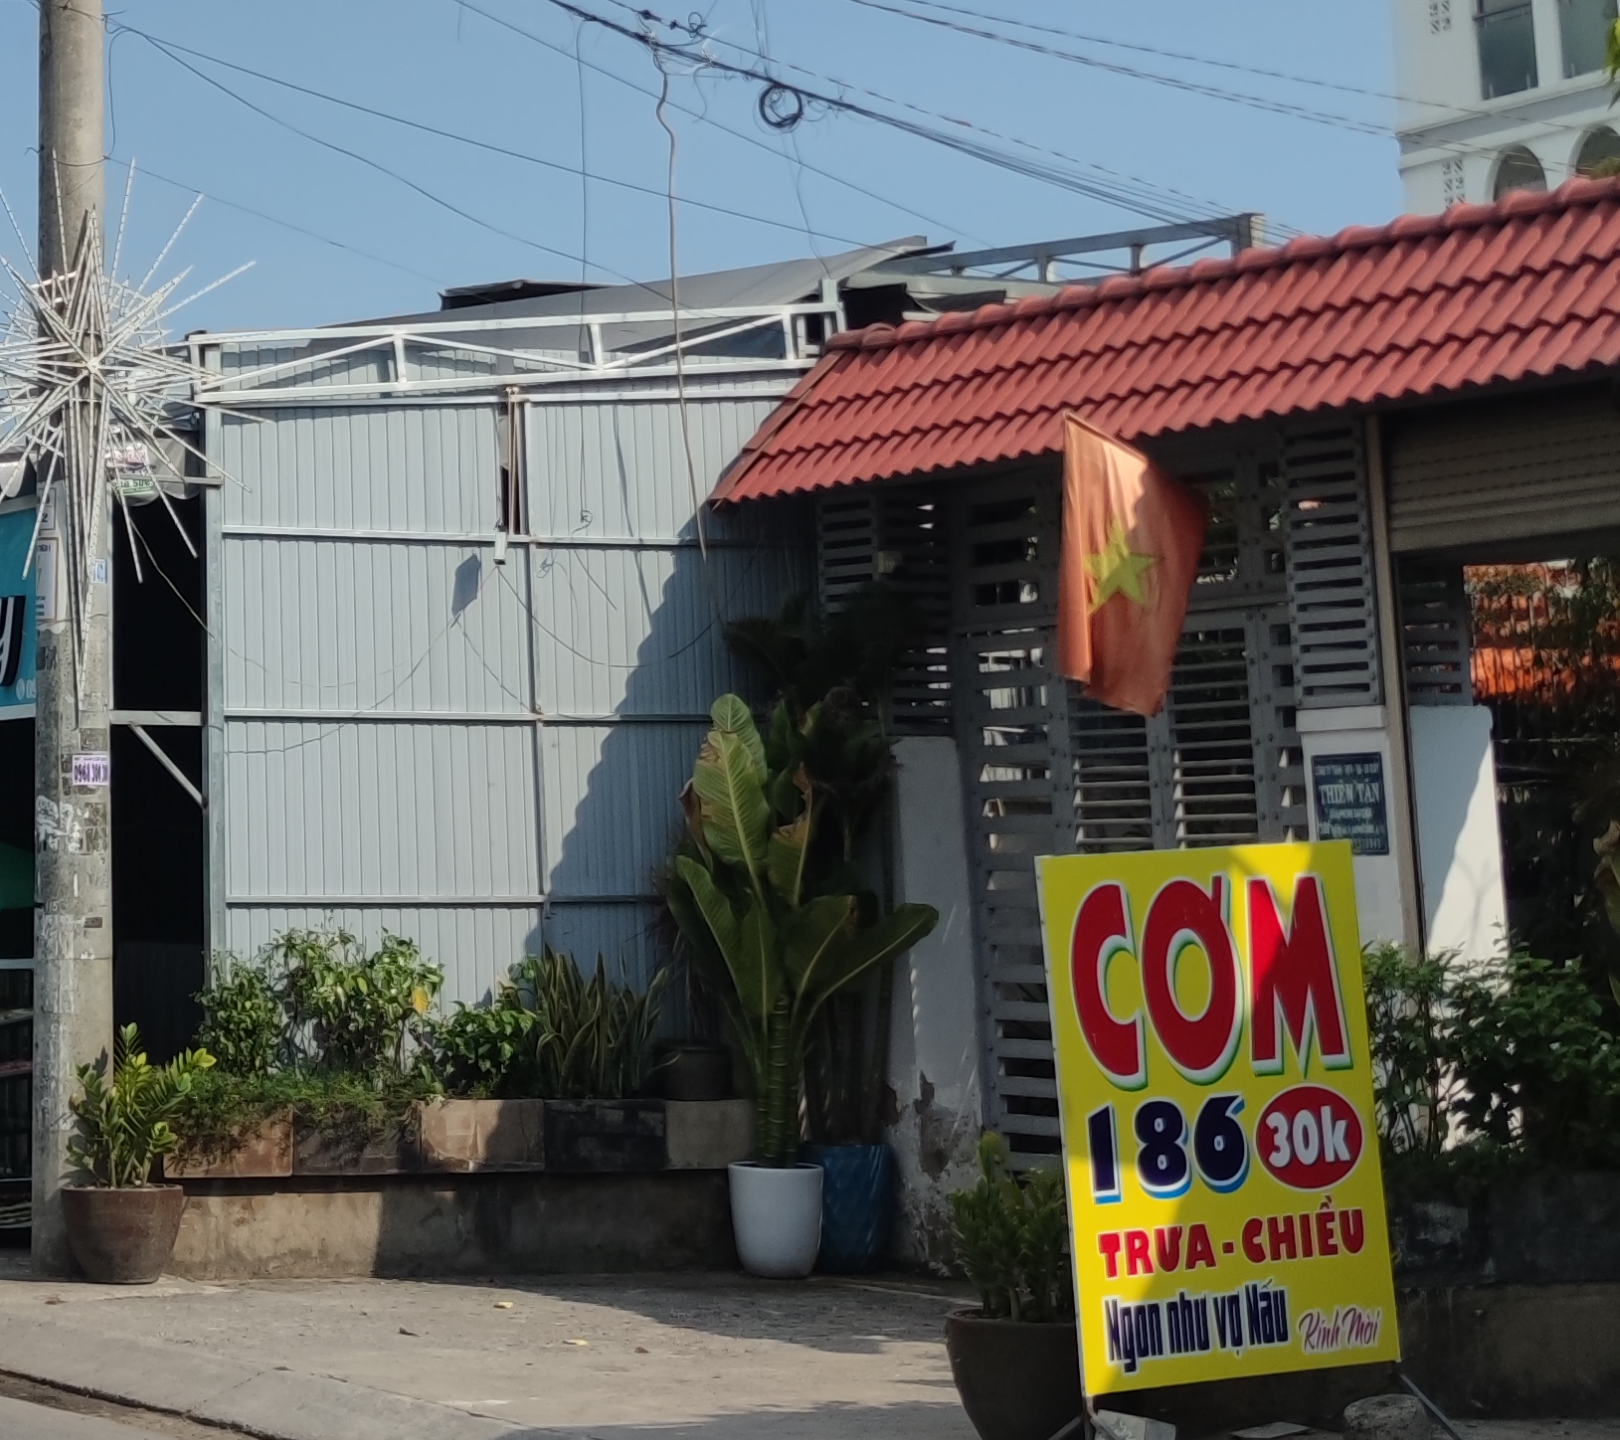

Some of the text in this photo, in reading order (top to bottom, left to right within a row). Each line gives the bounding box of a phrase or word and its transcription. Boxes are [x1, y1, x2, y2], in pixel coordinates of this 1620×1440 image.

[1069, 872, 1354, 1091] CƠM
[1087, 1092, 1251, 1205] 186
[1265, 1105, 1351, 1168] 30k
[1097, 1221, 1217, 1279] TRƯA
[1241, 1195, 1366, 1265] CHIỀU
[1103, 1278, 1290, 1375] Ngon như vợ Nấu
[1298, 1306, 1381, 1354] Kính Mời
